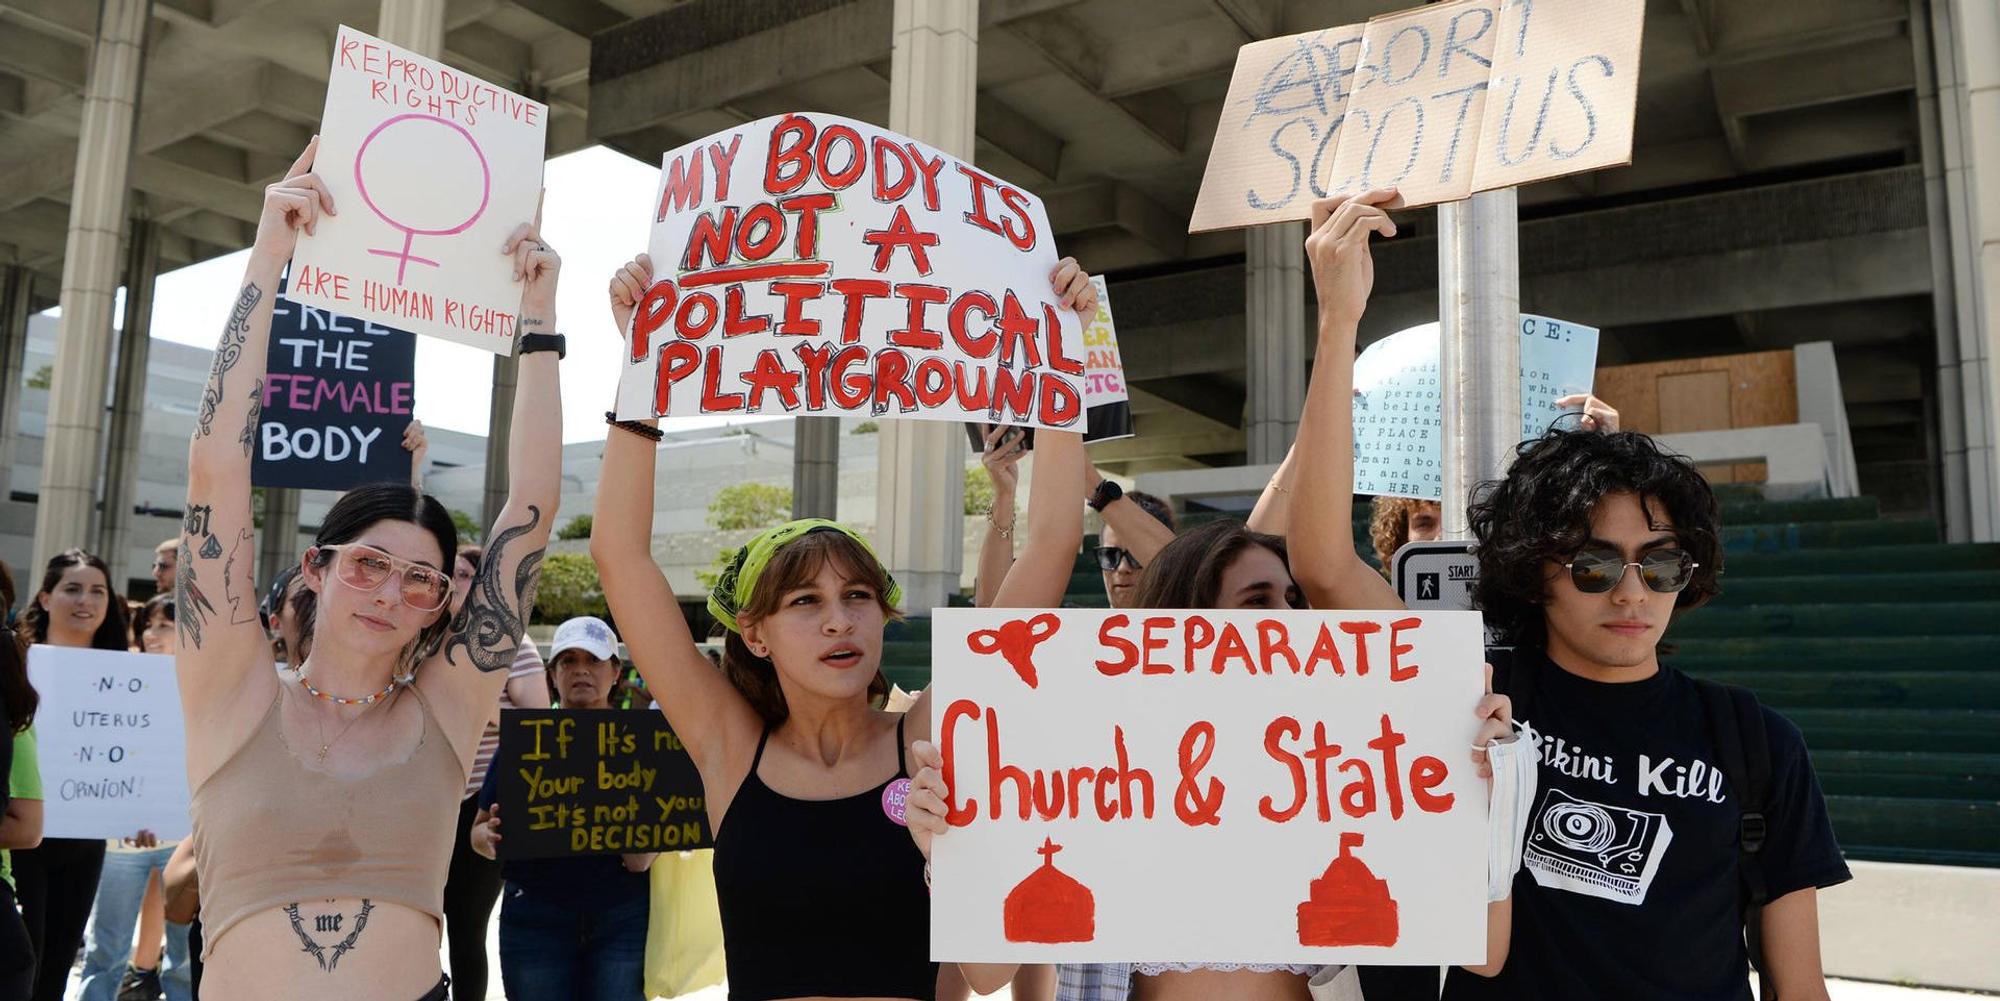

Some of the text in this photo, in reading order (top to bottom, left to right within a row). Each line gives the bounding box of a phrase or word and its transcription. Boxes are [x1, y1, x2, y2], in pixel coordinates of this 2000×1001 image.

[340, 35, 540, 127] REPRODUCTIVE
[371, 79, 478, 127] RIGHTS
[1247, 55, 1614, 210] SCOTUS
[657, 114, 1036, 253] MY BODY IS
[682, 192, 940, 277] NOT A
[296, 264, 516, 338] ARE HUMAN RIGHTS
[631, 279, 1087, 377] POLITICAL
[279, 338, 374, 372] THE
[262, 373, 411, 415] FEMALE
[651, 340, 1081, 428] PLAYGROUND
[262, 421, 382, 463] BODY
[1377, 427, 1428, 439] PLACE
[1380, 470, 1409, 479] and
[1388, 482, 1420, 495] HER
[1448, 565, 1474, 578] START
[1095, 614, 1422, 682] SEPARATE
[72, 710, 151, 728] UTERUS
[519, 718, 576, 761] If
[598, 721, 637, 757] It's
[598, 760, 657, 793] body
[941, 699, 1456, 827] Church & State
[1638, 754, 1726, 804] Kill
[528, 803, 586, 830] It's
[594, 795, 640, 823] not
[571, 821, 702, 850] DECISION
[315, 912, 343, 933] me
